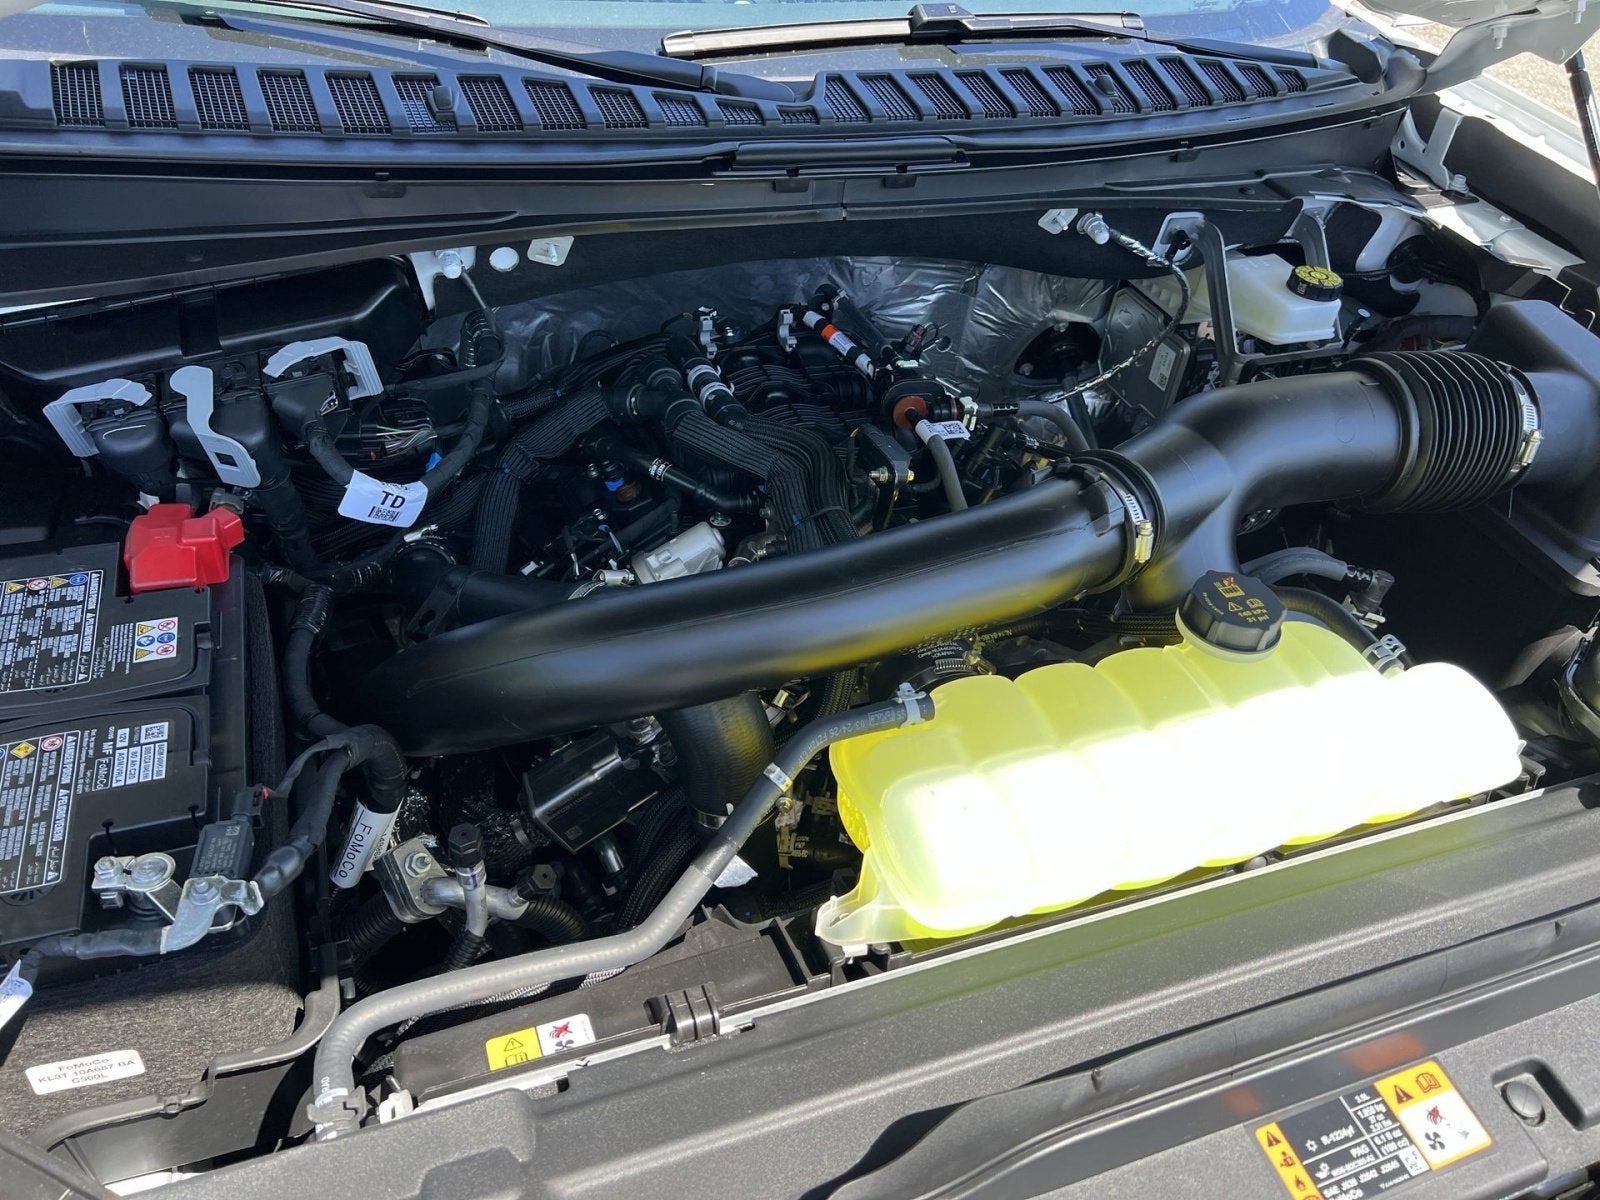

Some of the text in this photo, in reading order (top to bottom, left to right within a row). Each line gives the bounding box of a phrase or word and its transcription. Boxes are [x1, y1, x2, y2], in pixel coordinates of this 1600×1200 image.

[380, 490, 405, 508] TD
[102, 742, 112, 755] MF
[97, 758, 108, 789] FoMoCo
[339, 822, 373, 878] FoMoCo
[58, 1058, 109, 1072] FoMoCo
[1320, 1125, 1355, 1146] R-1234yf
[1350, 1144, 1370, 1158] PAG
[1323, 1187, 1340, 1198] SAE
